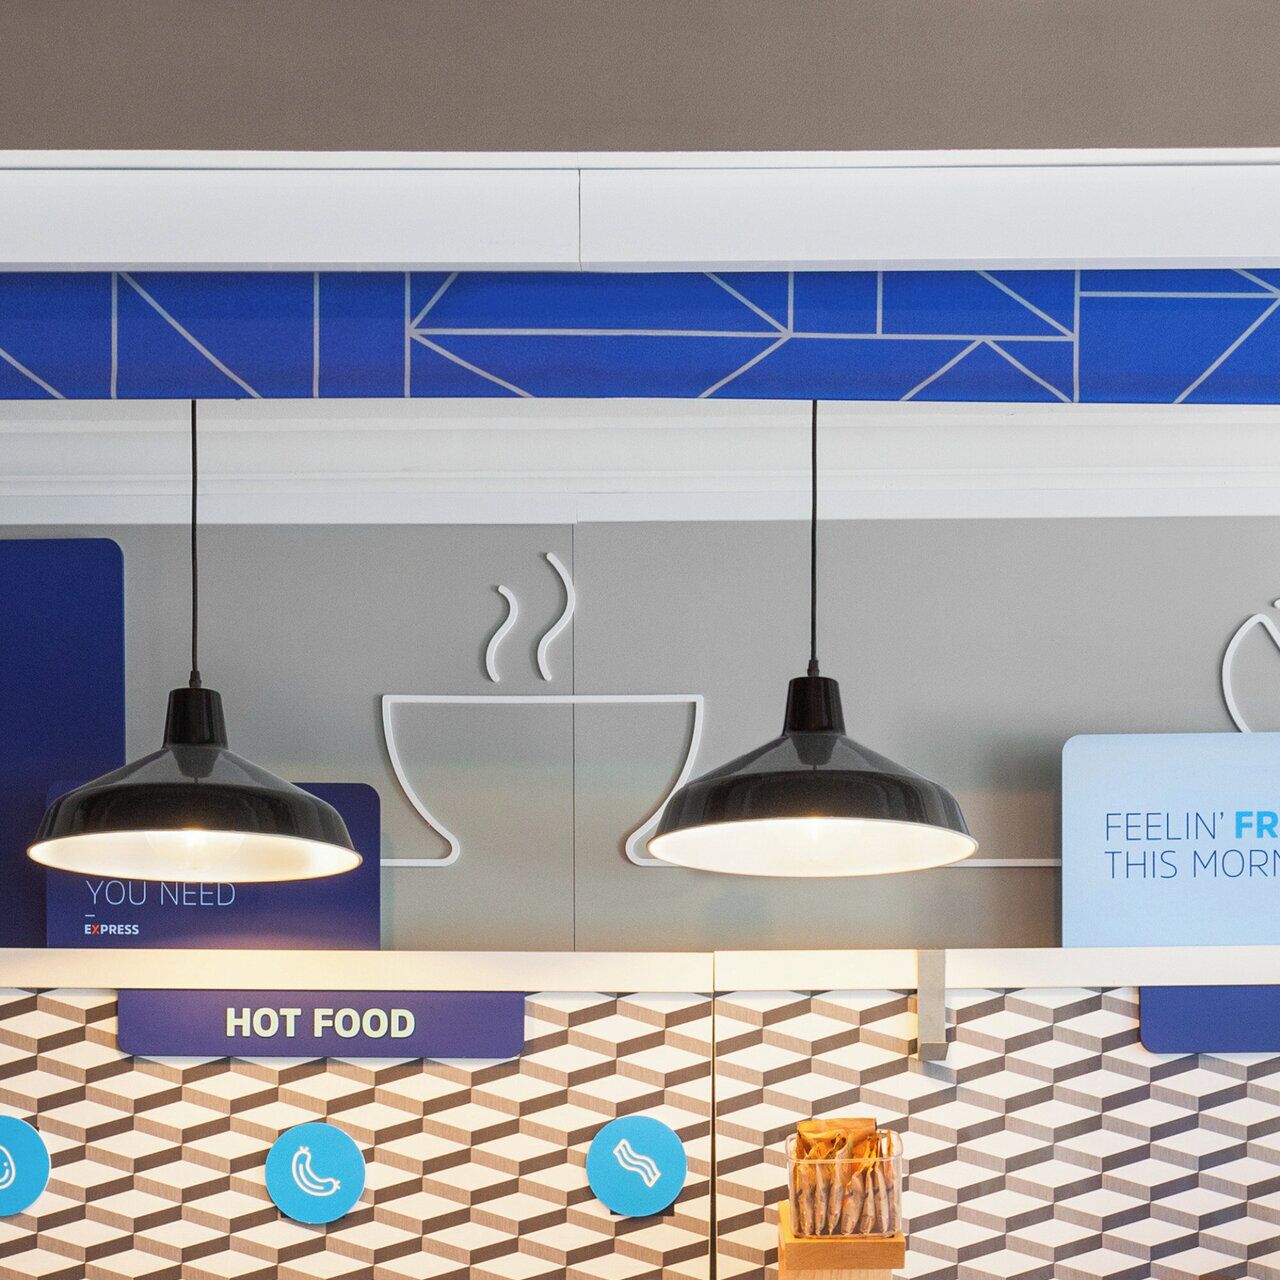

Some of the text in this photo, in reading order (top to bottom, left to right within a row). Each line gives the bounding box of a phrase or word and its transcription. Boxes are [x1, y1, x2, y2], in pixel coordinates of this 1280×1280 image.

[1104, 850, 1178, 879] THIS
[85, 880, 236, 906] YOU NEED
[84, 924, 140, 935] EXPRESS
[226, 1007, 416, 1039] HOT FOOD
